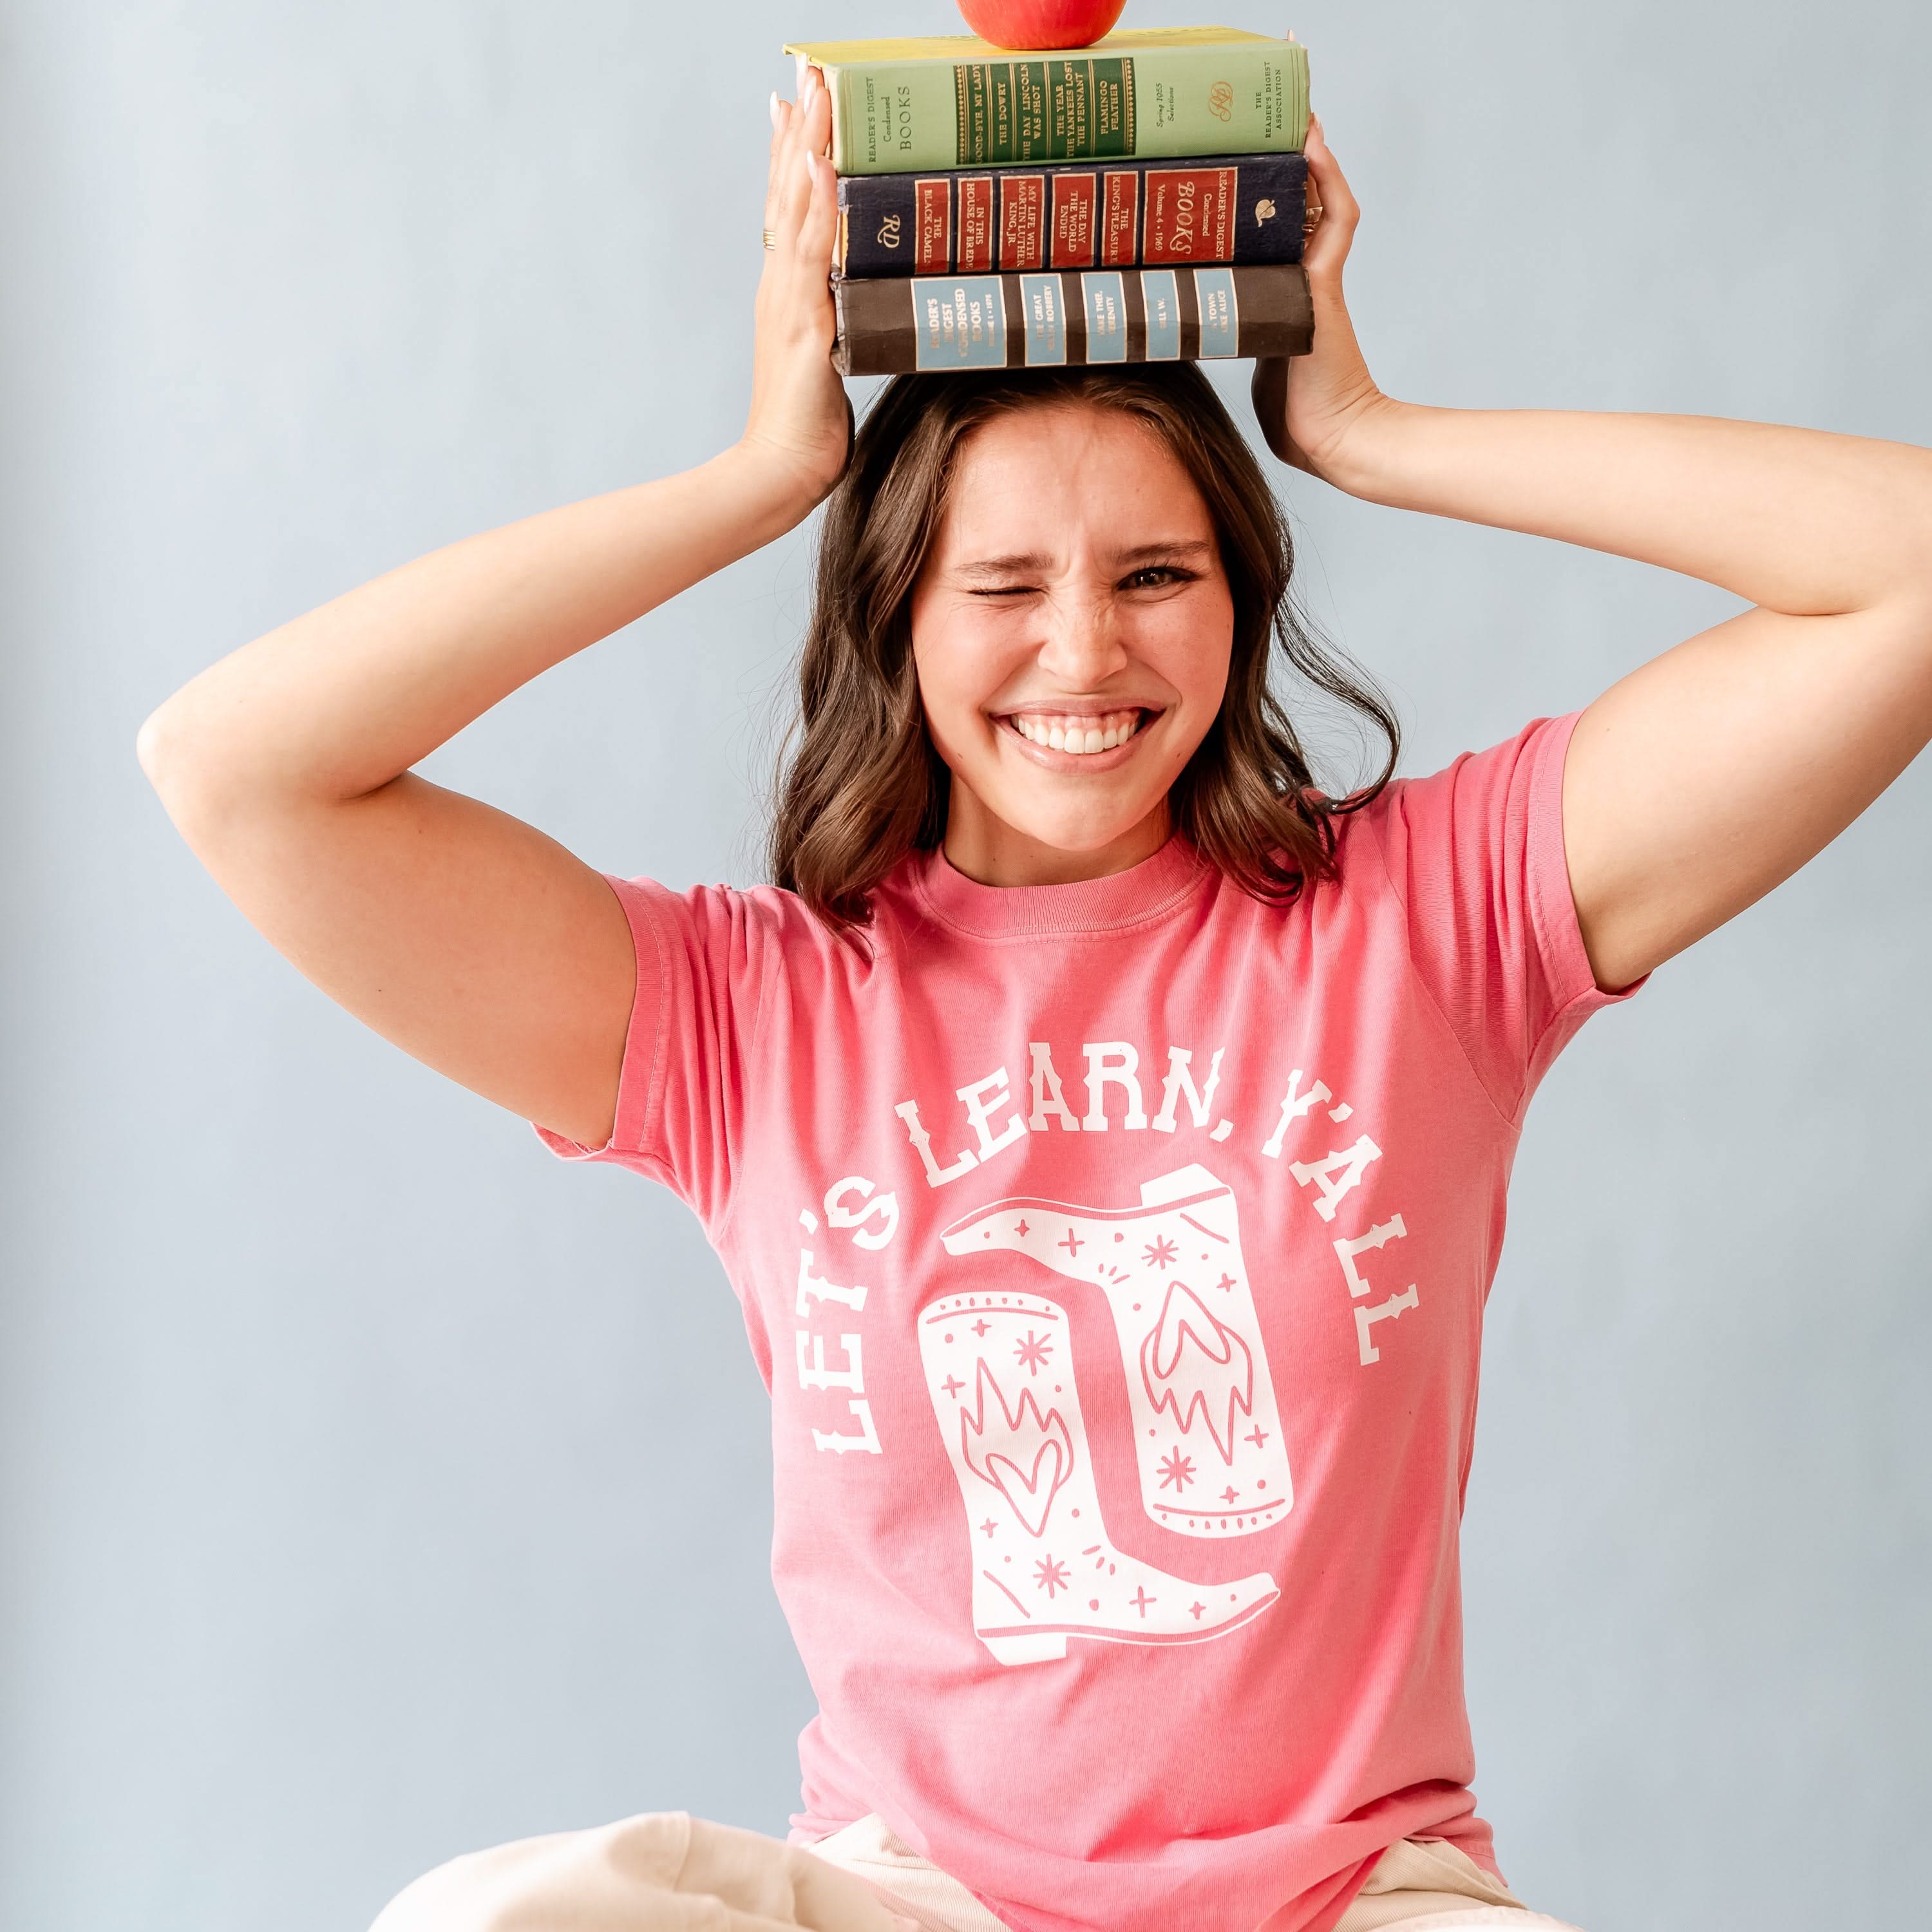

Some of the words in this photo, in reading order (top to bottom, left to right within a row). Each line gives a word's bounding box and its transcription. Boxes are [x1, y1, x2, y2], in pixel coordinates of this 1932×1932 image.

[972, 64, 981, 91] LADY
[1020, 63, 1030, 111] LINCOLN
[1064, 61, 1073, 87] LOST
[866, 77, 875, 112] DIGEST
[974, 94, 982, 107] MY
[998, 82, 1007, 120] DOWRY
[1032, 85, 1041, 114] SHOT
[1075, 72, 1085, 122] PENNANT
[1100, 80, 1108, 135] FLAMINGO
[1110, 83, 1119, 131] FEATHER
[881, 96, 891, 142] Condensed
[898, 86, 911, 150] BOOKS
[868, 116, 876, 162] READER'S
[924, 189, 933, 224] BLACK
[1018, 180, 1027, 223] MARTIN
[1028, 185, 1036, 203] MY
[1070, 190, 1078, 212] THE
[1079, 199, 1087, 221] THE
[1112, 176, 1121, 211] KING'S
[1156, 184, 1166, 216] Volume
[1217, 171, 1227, 221] READER'S
[934, 216, 942, 239] THE
[967, 220, 974, 233] OF
[976, 207, 984, 218] IN
[1008, 202, 1018, 231] KING,
[1059, 204, 1068, 239] ENDED
[1121, 208, 1129, 230] THE
[1170, 181, 1195, 255] BOOKS
[1202, 193, 1212, 236] Condensed
[877, 214, 900, 249] RD
[923, 225, 933, 263] CAMEL
[976, 221, 984, 245] THIS
[1017, 224, 1026, 267] LUTHER
[1027, 231, 1035, 260] WITH
[1068, 213, 1077, 252] WORLD
[1078, 222, 1086, 243] DAY
[1110, 212, 1119, 263] PLEASURE
[1155, 232, 1163, 251] 1969
[1216, 222, 1225, 259] DIGEST
[1034, 294, 1043, 321] GREAT
[1208, 293, 1217, 321] TOWN
[1218, 290, 1228, 313] ALICE
[796, 1176, 900, 1455] LET'S
[894, 1041, 1234, 1188] LEARN,
[1261, 1069, 1419, 1366] Y'ALL
